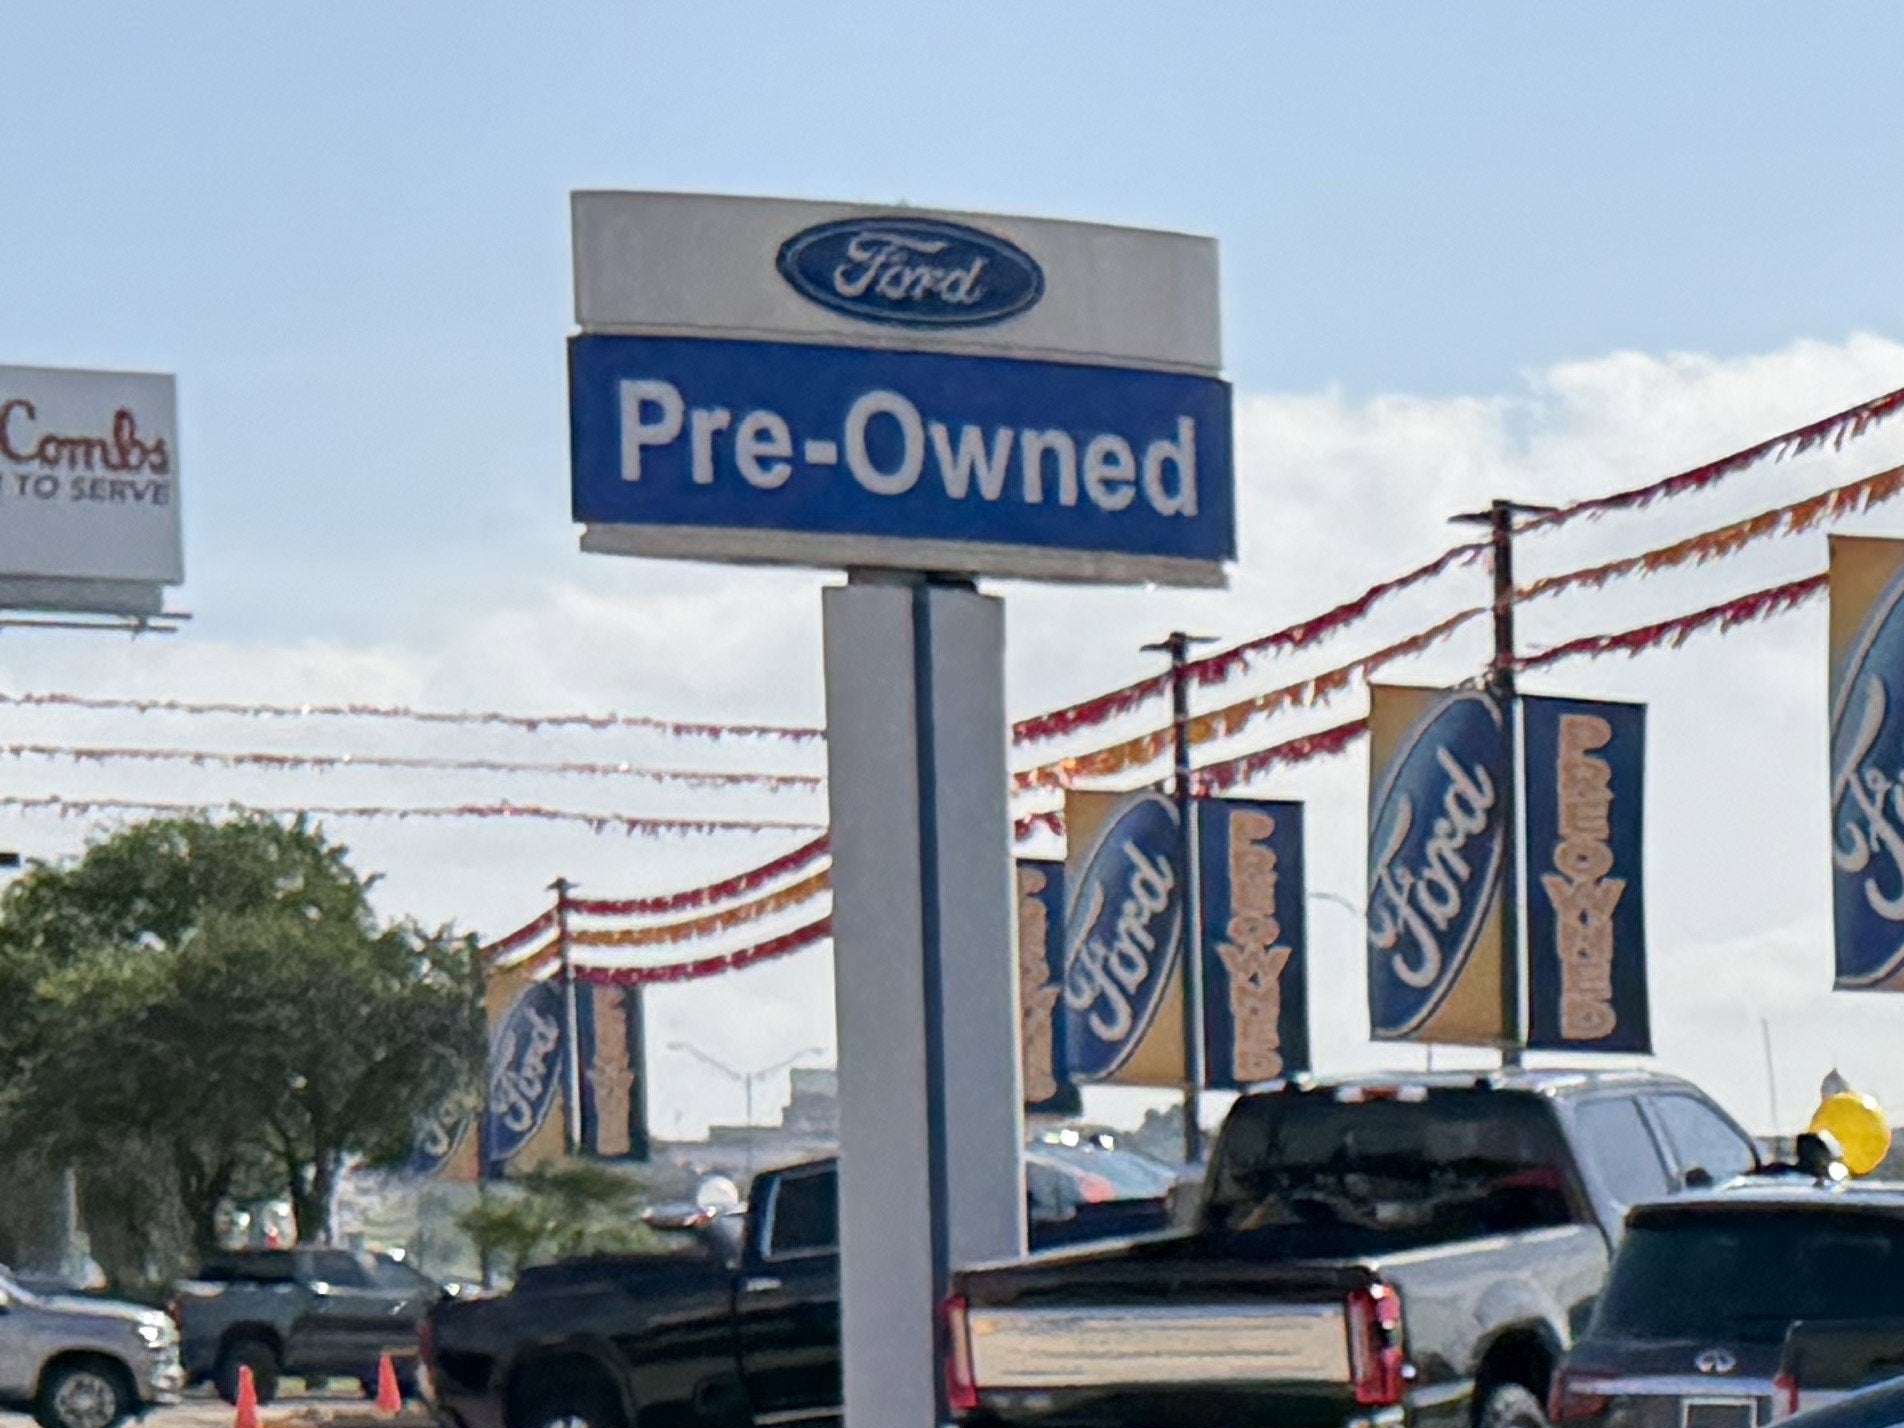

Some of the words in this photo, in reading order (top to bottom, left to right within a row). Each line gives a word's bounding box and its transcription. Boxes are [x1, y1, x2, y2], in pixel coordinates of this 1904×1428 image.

[834, 232, 988, 304] Ford
[16, 474, 60, 499] TO
[71, 476, 170, 505] SERVE
[619, 379, 1198, 518] Pre-Owned
[1367, 745, 1494, 988] Ford
[1063, 840, 1175, 1042] Ford
